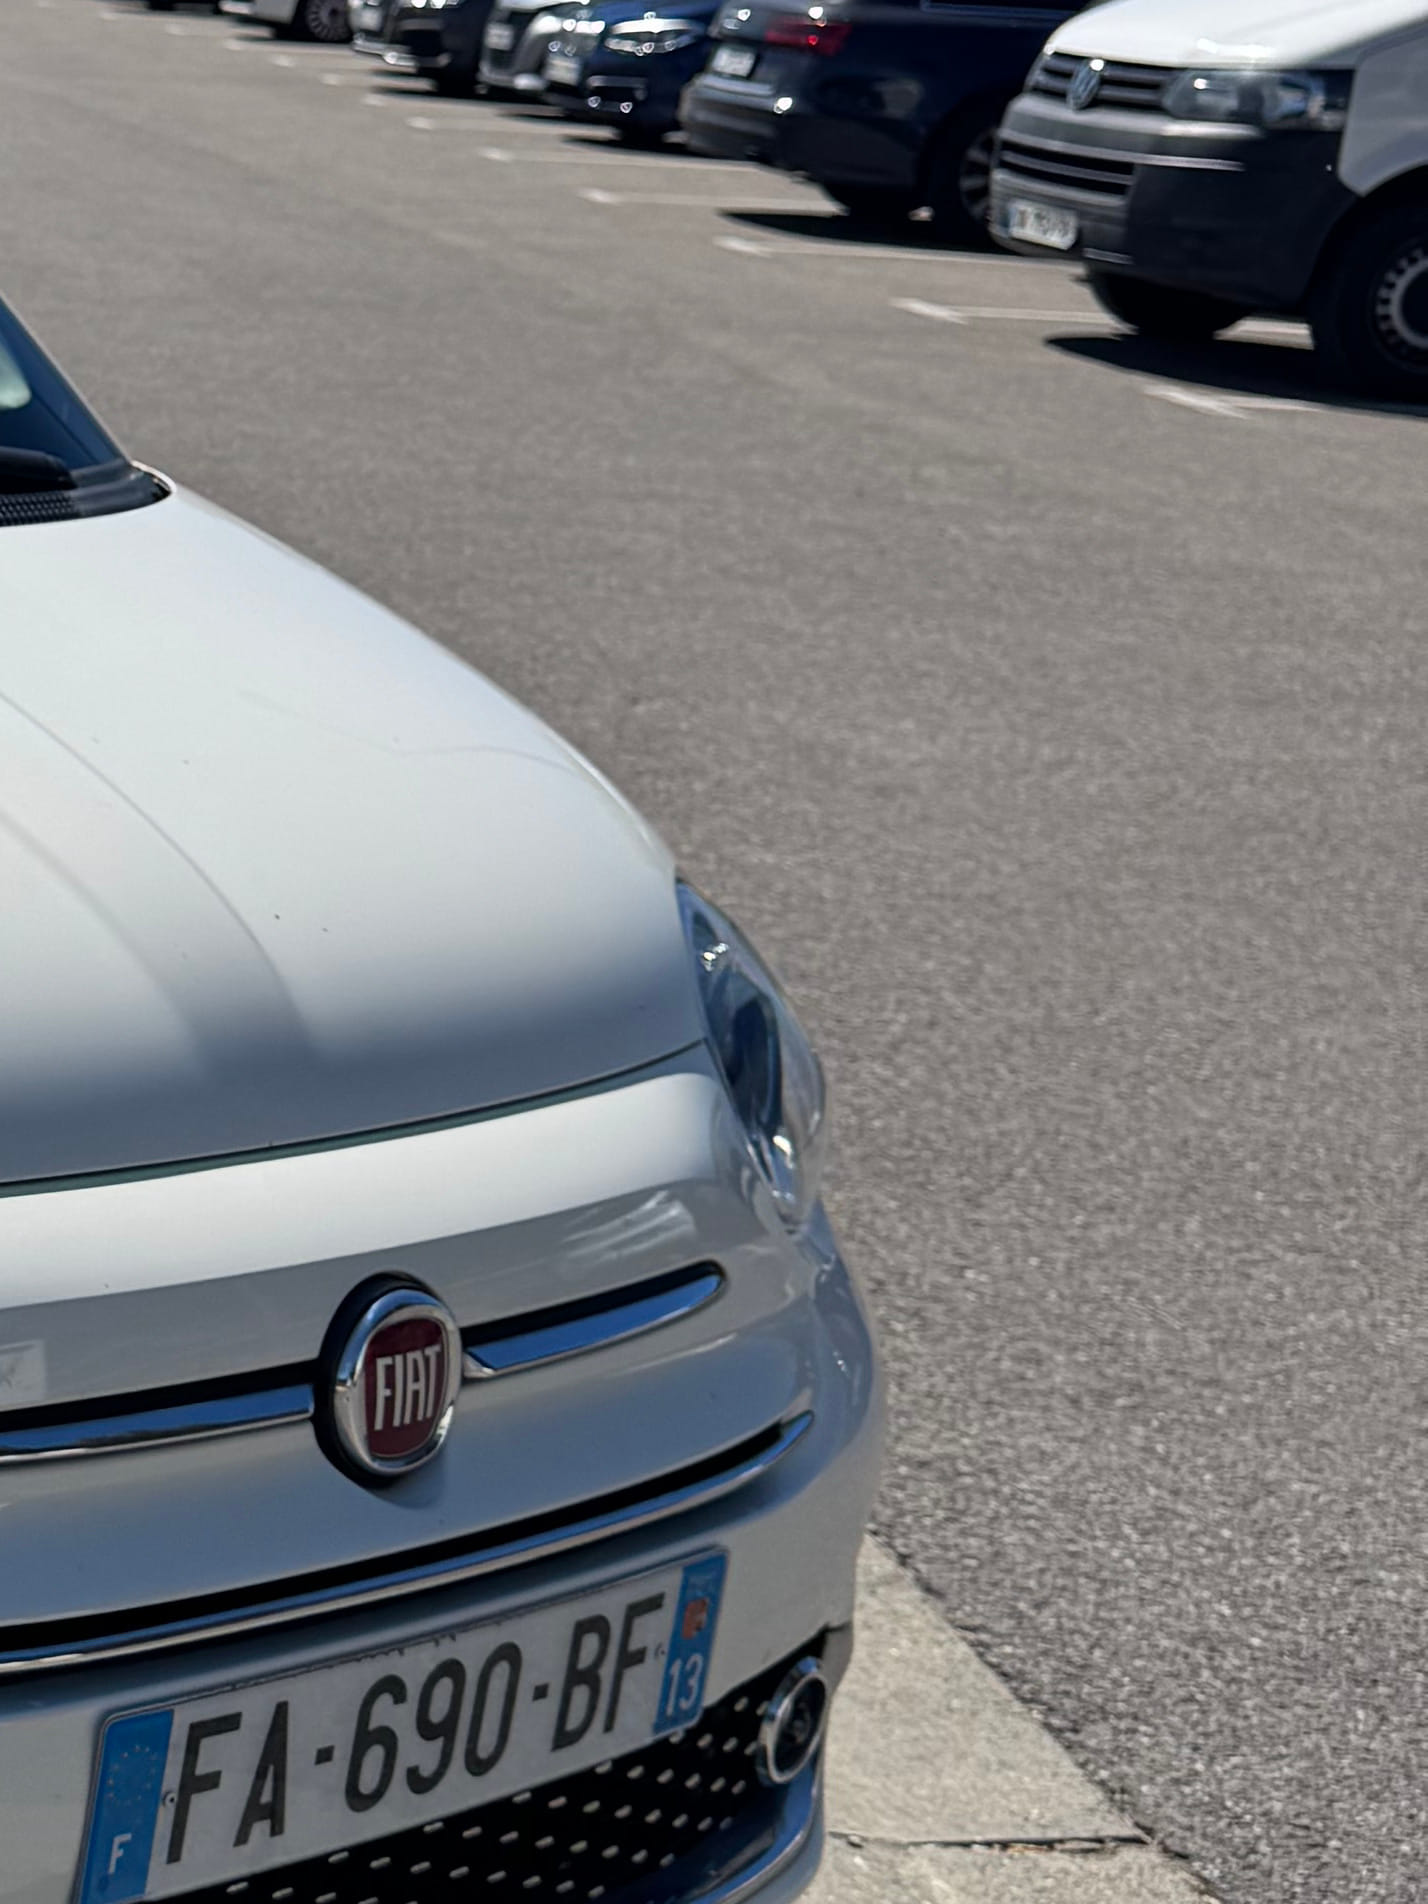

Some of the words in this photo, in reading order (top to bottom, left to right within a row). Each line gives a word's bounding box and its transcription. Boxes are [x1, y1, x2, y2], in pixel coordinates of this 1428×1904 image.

[374, 1345, 441, 1431] FIAT
[108, 1833, 133, 1875] F
[166, 1592, 666, 1865] FA-690-BF
[666, 1653, 704, 1717] 13
